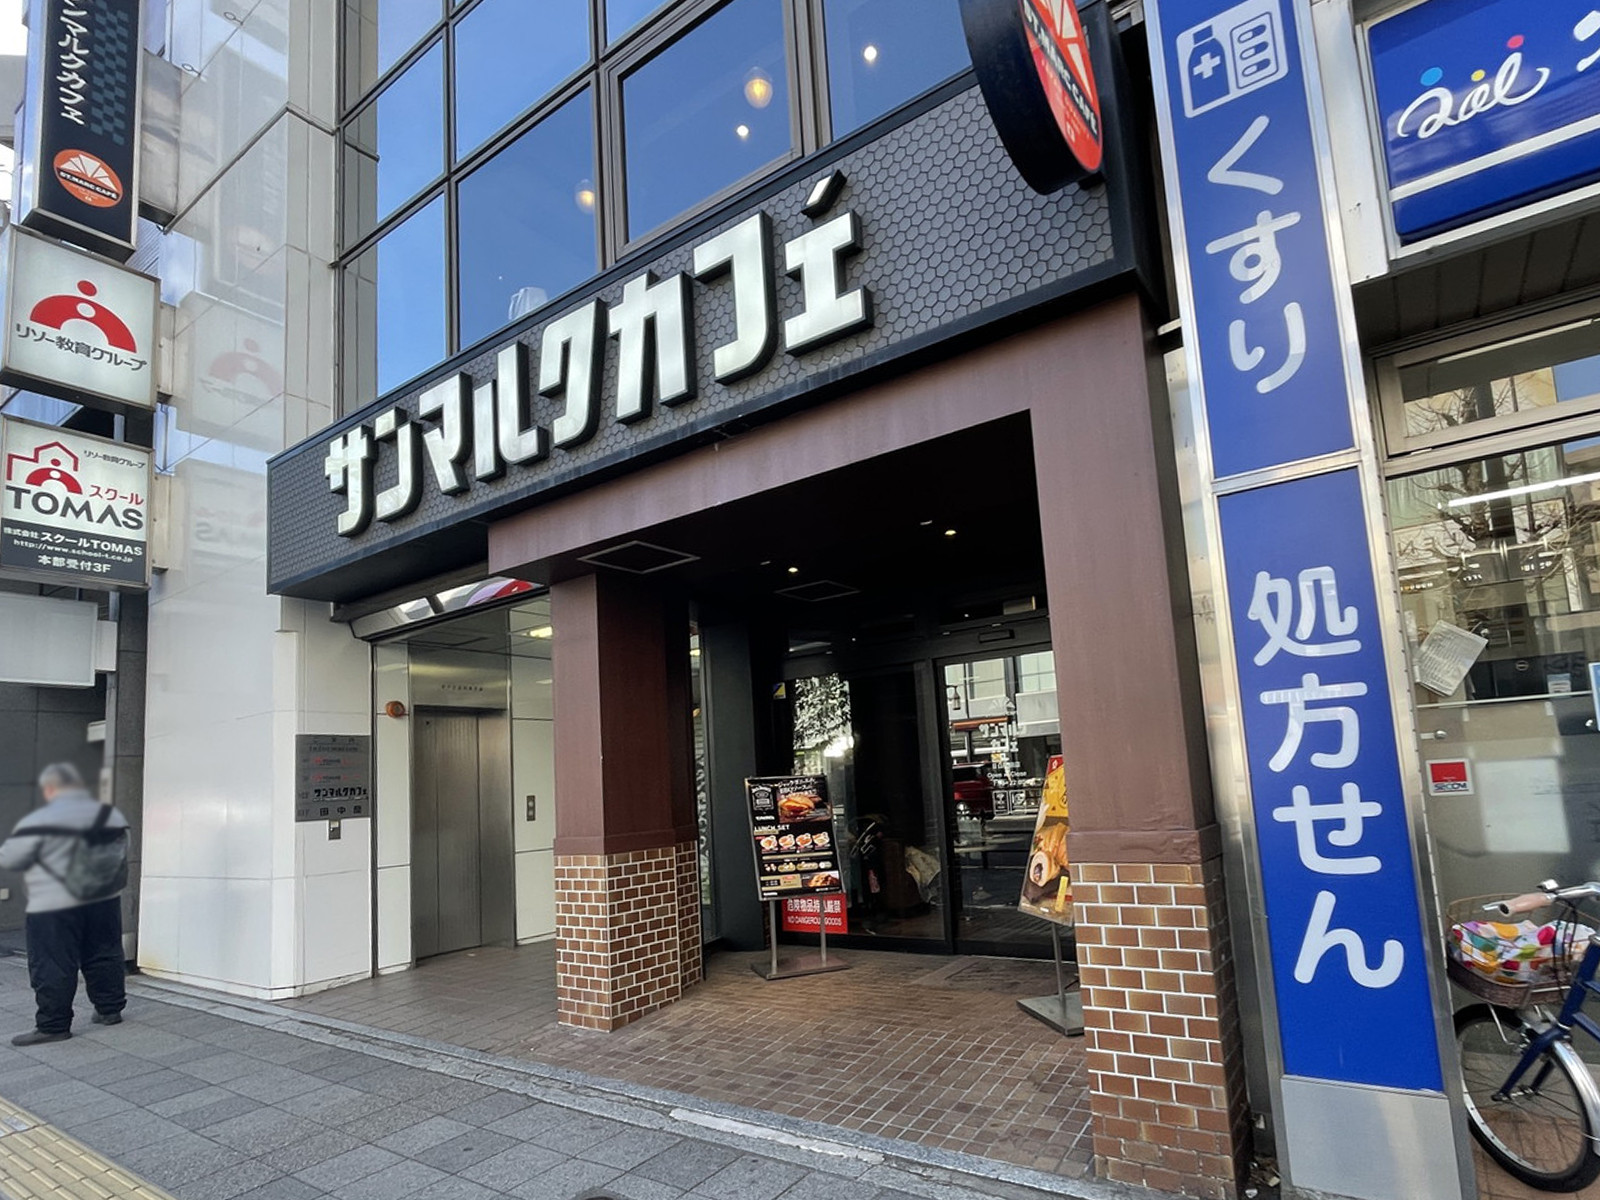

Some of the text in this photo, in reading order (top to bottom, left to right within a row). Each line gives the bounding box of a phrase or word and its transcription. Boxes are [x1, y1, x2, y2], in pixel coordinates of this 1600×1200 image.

[1205, 114, 1307, 394] くすり
[15, 322, 148, 372] リソー教育グループ
[323, 169, 873, 537] サンマルクカフェ
[5, 484, 144, 531] TOMAS
[89, 484, 145, 505] スクール
[38, 554, 112, 573] 本部受付3F
[1246, 565, 1405, 989] 処方せん
